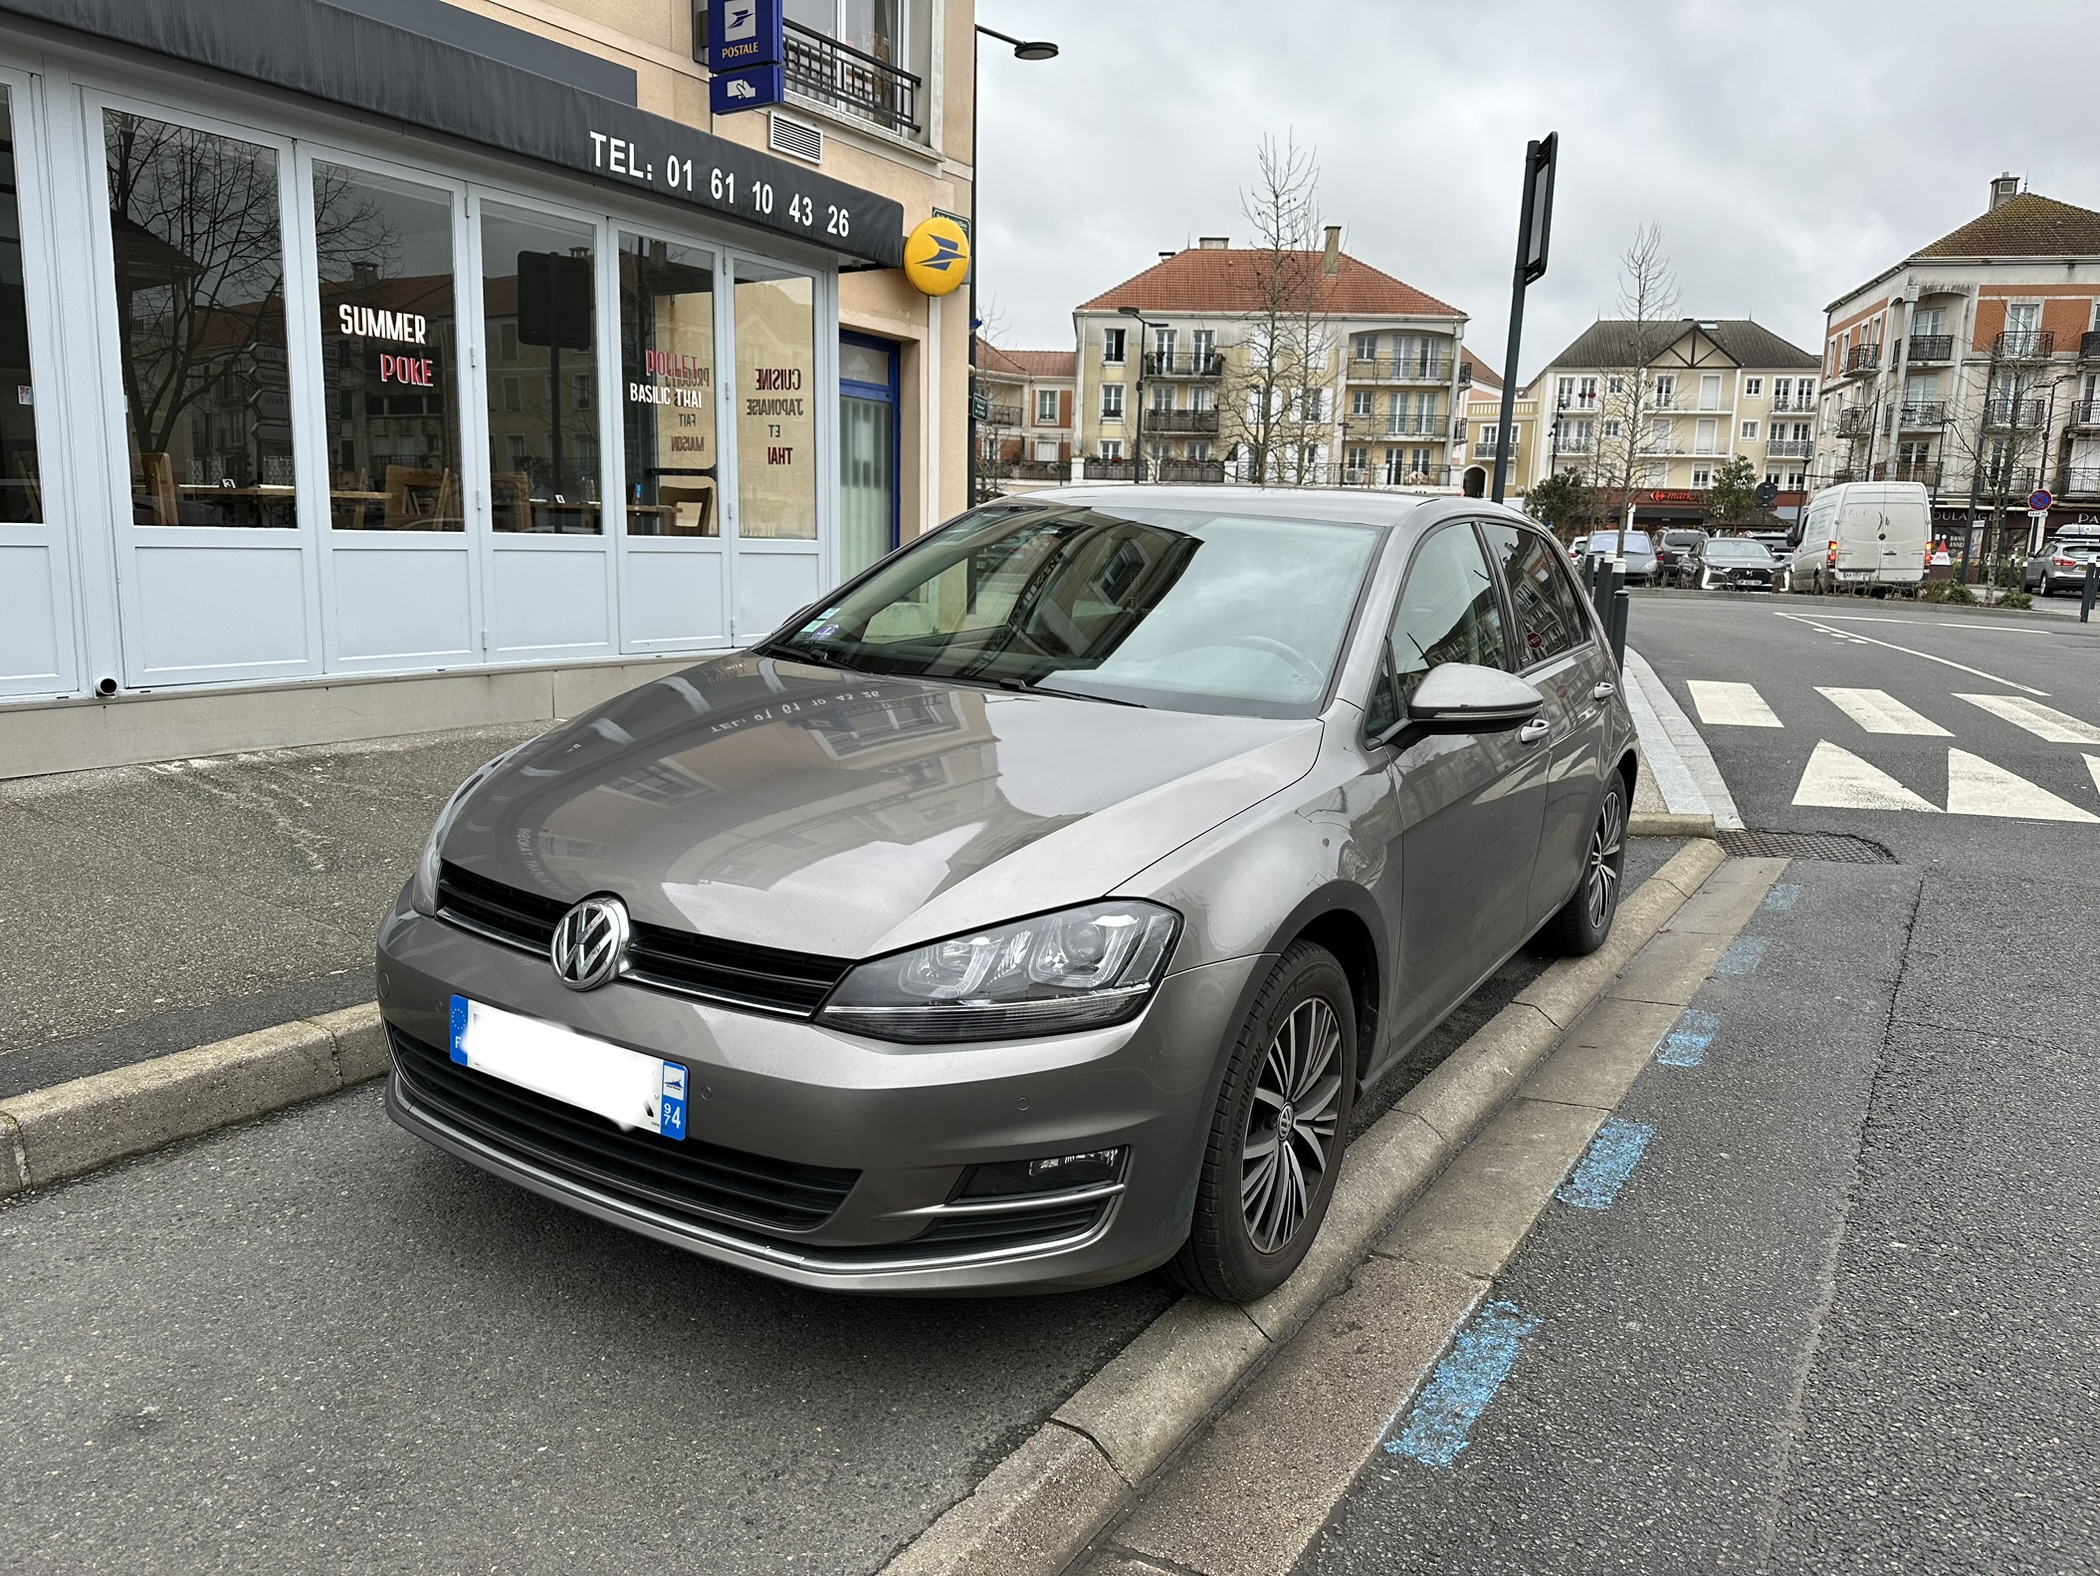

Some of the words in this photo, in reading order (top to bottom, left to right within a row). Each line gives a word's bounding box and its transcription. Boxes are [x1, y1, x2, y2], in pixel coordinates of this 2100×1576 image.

[722, 42, 759, 58] POSTALE
[589, 131, 652, 180] TEL:
[666, 154, 693, 192] 01
[710, 168, 735, 204] 61
[752, 181, 773, 214] 10
[788, 193, 813, 227] 43
[826, 205, 849, 238] 26
[339, 303, 426, 344] SUMMER
[380, 353, 434, 387] POKE
[630, 382, 671, 405] BASILIC
[675, 388, 702, 409] THAI
[2078, 513, 2100, 524] PA
